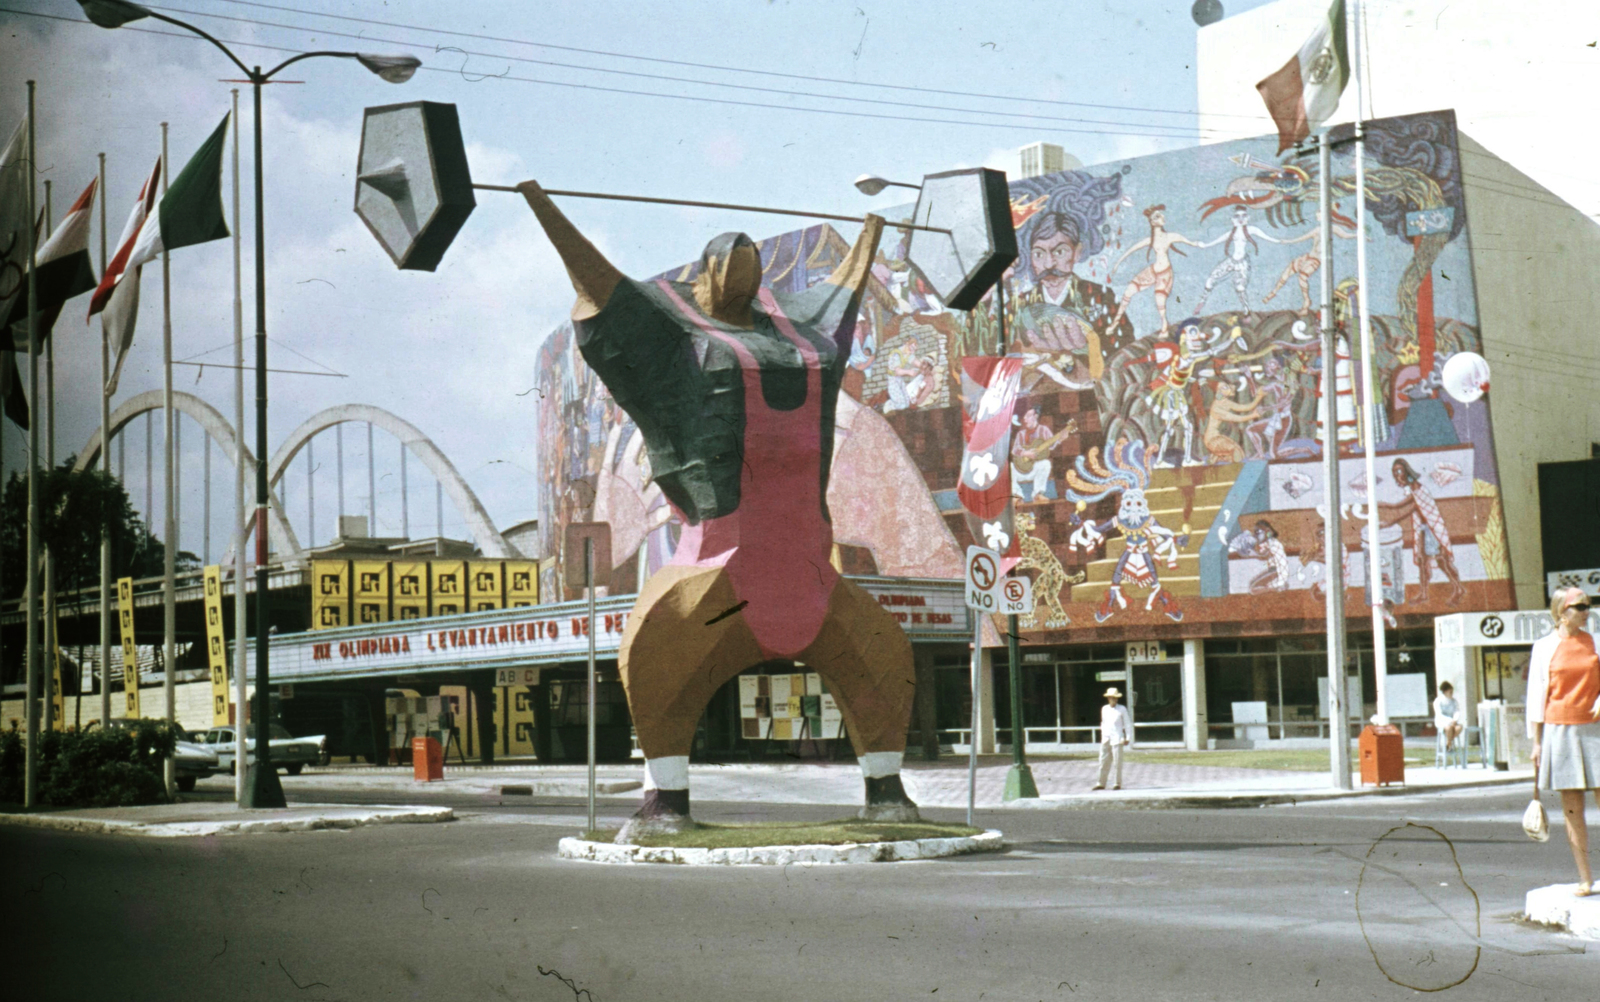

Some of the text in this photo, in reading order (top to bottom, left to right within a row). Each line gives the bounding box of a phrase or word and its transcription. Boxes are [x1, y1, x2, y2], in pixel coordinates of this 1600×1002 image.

[971, 590, 993, 608] NO
[1007, 602, 1024, 611] NO
[313, 612, 631, 660] XIX OLIMPIADA LEVANTAMIENTO DE PE
[524, 670, 533, 682] C
